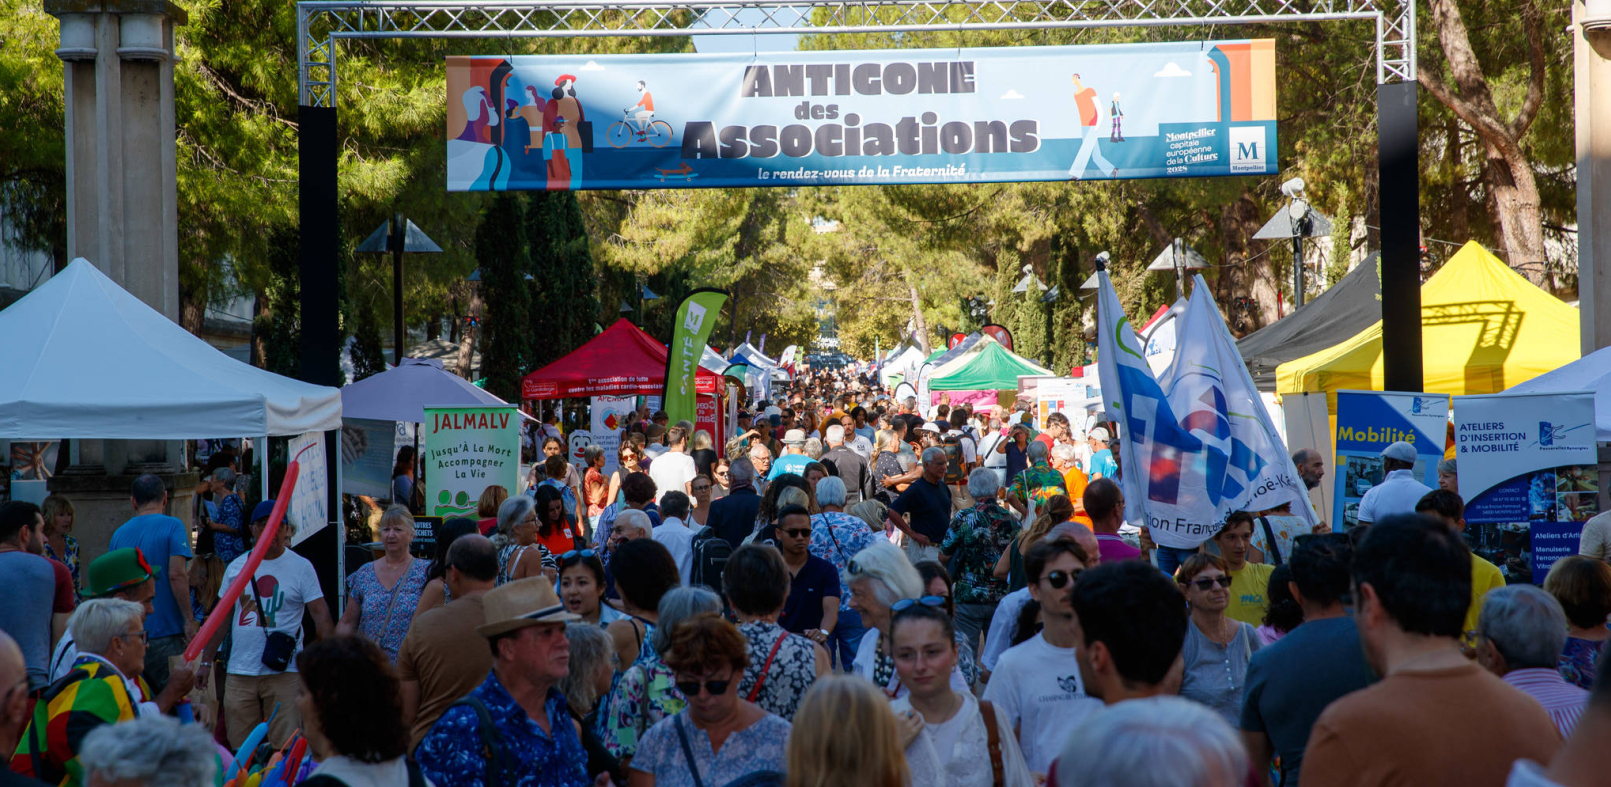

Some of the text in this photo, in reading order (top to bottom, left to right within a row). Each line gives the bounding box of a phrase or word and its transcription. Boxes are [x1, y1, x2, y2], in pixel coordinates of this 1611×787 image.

[742, 61, 975, 98] ANTIGONE
[795, 101, 839, 120] des
[681, 111, 1040, 159] Associations
[1166, 128, 1216, 142] Montpellier
[1170, 140, 1199, 149] capitale
[1237, 142, 1259, 160] M
[1166, 146, 1212, 158] européenne
[1184, 152, 1218, 164] Culture
[758, 162, 966, 180] le rendez-vous de la Fraternité
[1167, 165, 1188, 175] 2028
[680, 336, 693, 395] SANTÉ
[433, 413, 510, 434] JALMALV
[1460, 422, 1505, 431] ATELIERS
[1338, 426, 1416, 444] Mobilité
[1460, 432, 1526, 442] D'INSERTION
[431, 441, 469, 460] Jusqu'À
[473, 443, 484, 453] La
[488, 444, 512, 457] Mort
[1461, 441, 1519, 453] & MOBILITÉ
[438, 458, 504, 469] Accompagner
[455, 469, 486, 478] La Vie
